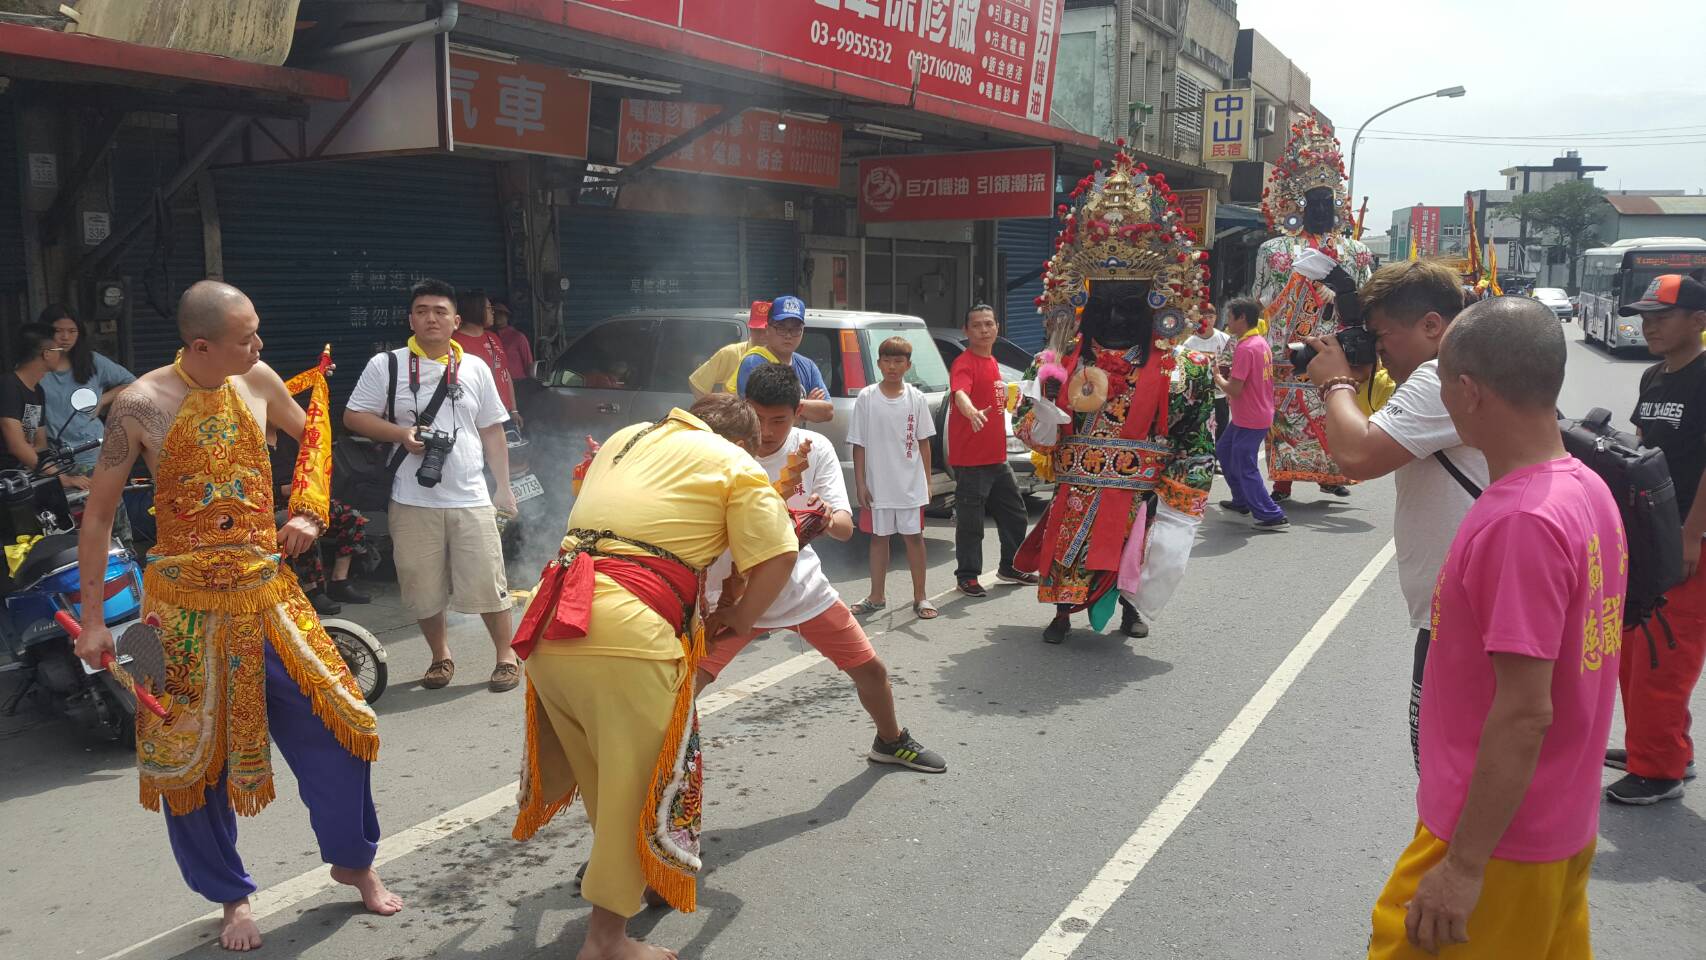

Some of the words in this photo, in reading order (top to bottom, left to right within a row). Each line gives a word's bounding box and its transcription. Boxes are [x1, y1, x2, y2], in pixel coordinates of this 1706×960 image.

[810, 20, 893, 64] 03-9955532
[1213, 94, 1244, 142] 中山
[1212, 144, 1242, 157] 民宿
[906, 177, 970, 198] 巨力機油
[976, 173, 1046, 195] 引領潮流
